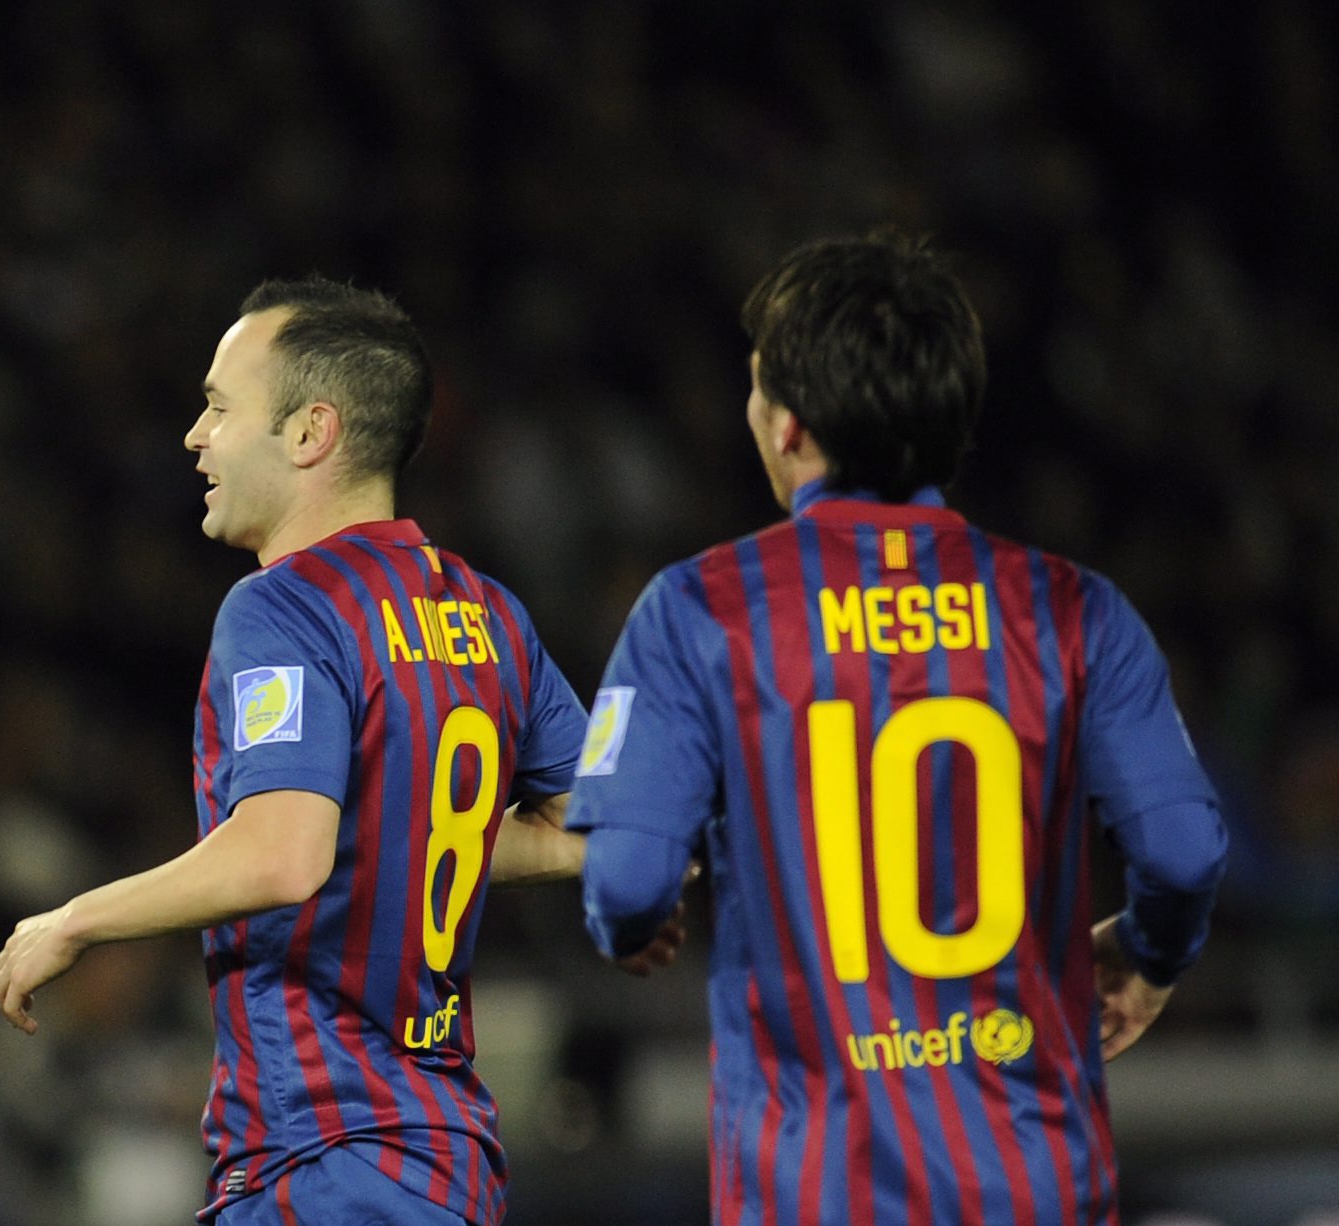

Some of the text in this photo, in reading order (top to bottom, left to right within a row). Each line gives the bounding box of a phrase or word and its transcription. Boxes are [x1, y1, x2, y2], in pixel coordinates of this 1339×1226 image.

[818, 582, 991, 655] MESSI
[422, 705, 501, 973] 8
[808, 695, 1027, 984] 10
[847, 1011, 967, 1071] unicef
